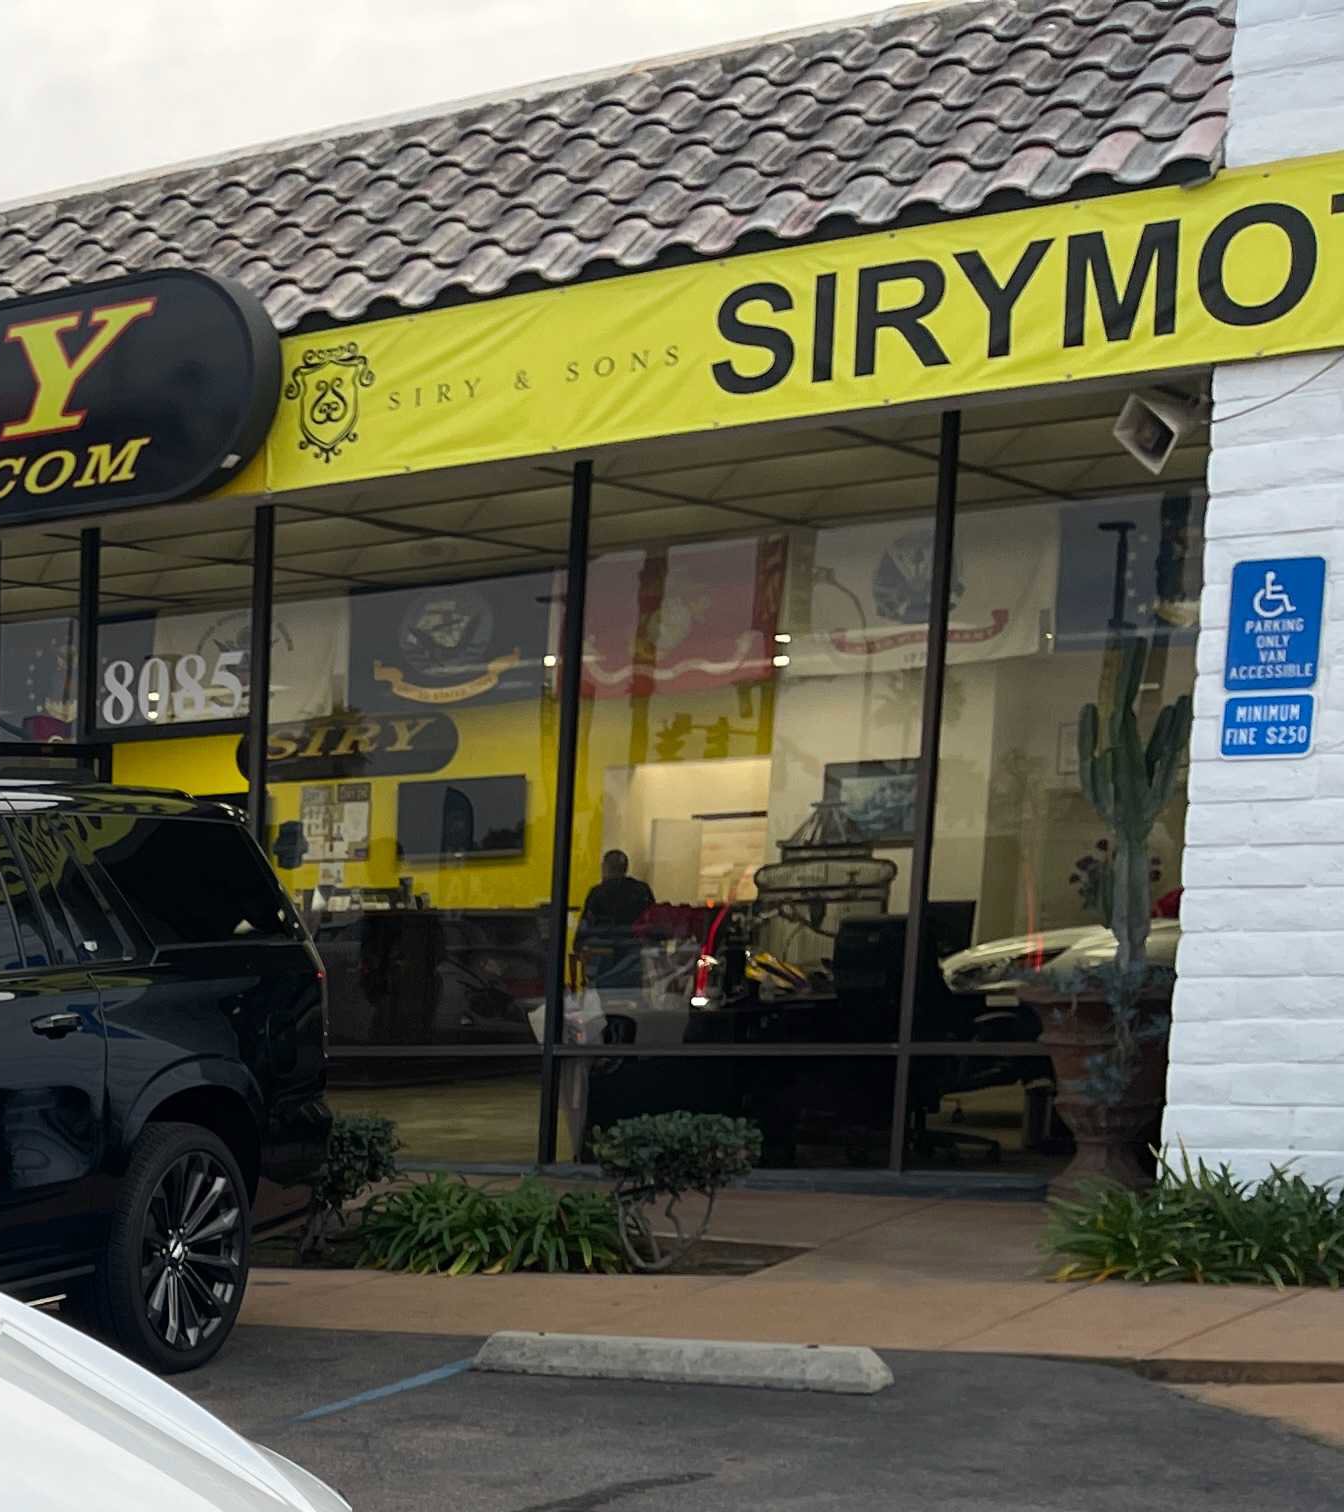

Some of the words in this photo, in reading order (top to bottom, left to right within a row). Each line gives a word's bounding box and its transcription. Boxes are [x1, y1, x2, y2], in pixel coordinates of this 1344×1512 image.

[712, 193, 1344, 395] SIRYMO
[387, 377, 484, 412] SIRY
[513, 368, 533, 391] &
[565, 345, 681, 384] SONS
[1245, 618, 1304, 633] PARKING
[1256, 635, 1290, 648] ONLY
[1260, 650, 1286, 662] VAN
[1230, 663, 1313, 680] ACCESSIBLE
[101, 650, 246, 724] 8085
[1236, 704, 1300, 723] MINIMUM
[265, 718, 440, 760] SIRY
[1225, 728, 1257, 746] FINE
[1266, 726, 1308, 745] $250
